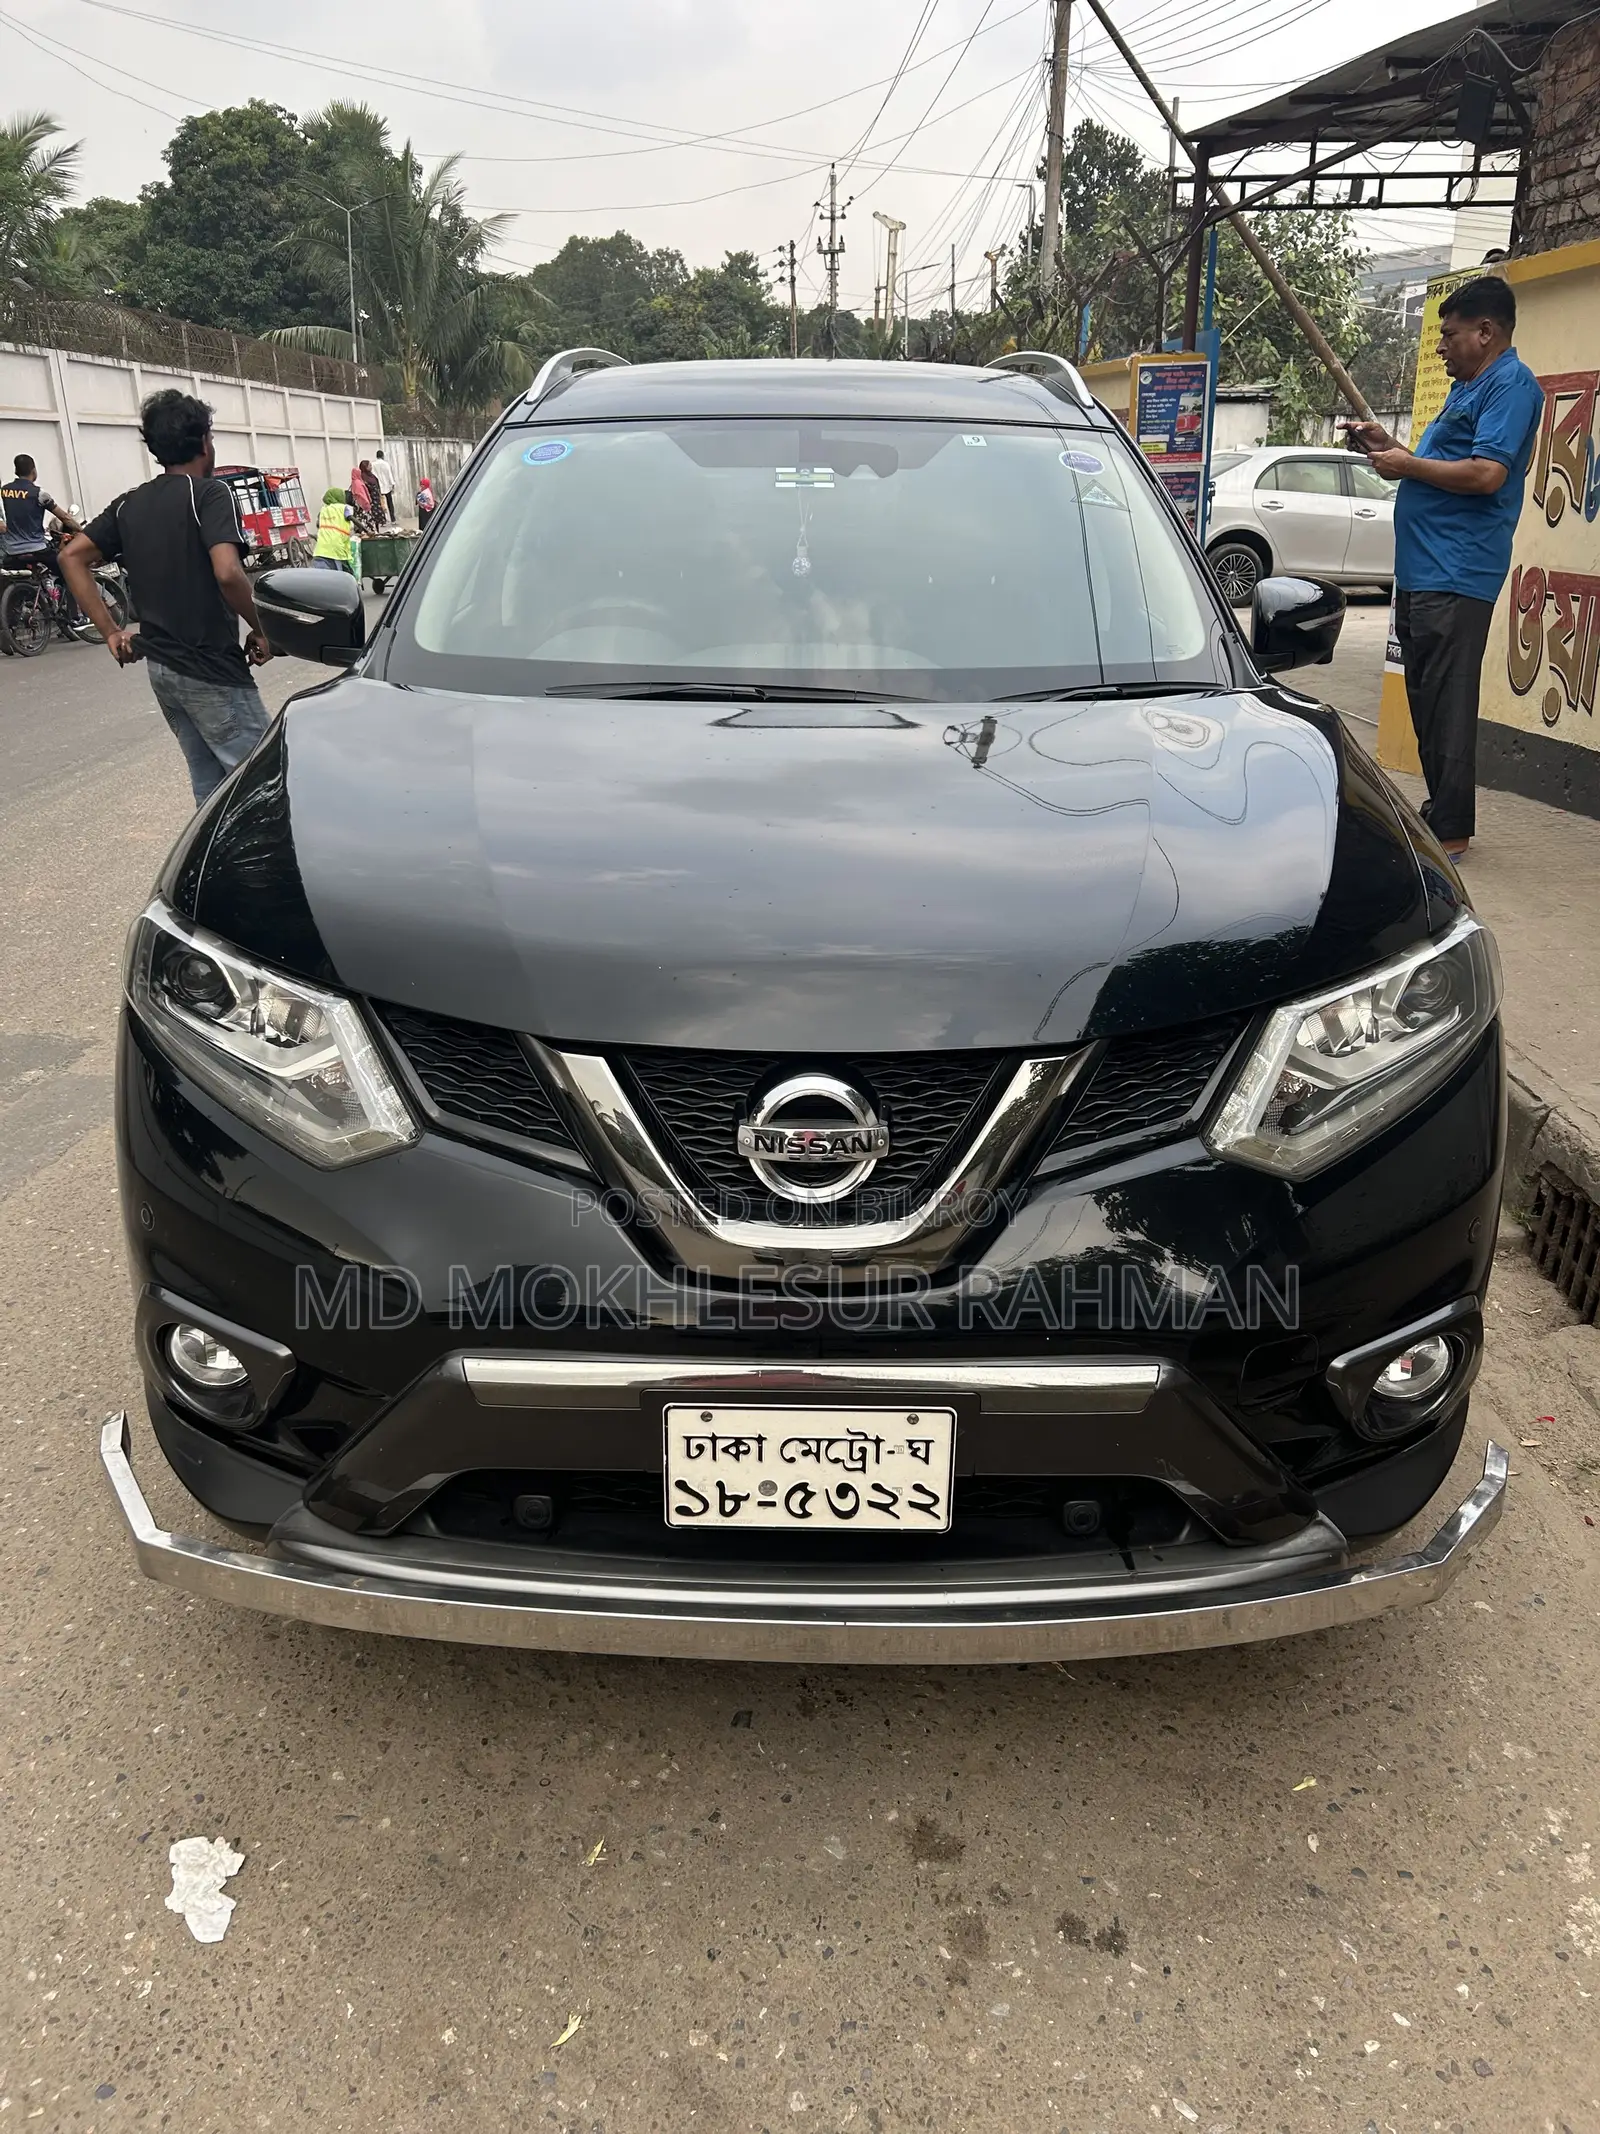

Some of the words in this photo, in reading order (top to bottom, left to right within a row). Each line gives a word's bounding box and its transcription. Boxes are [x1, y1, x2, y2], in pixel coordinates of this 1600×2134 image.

[2, 489, 28, 499] NAVY
[754, 1134, 872, 1155] NISSAN
[682, 1432, 768, 1463] ঢাকা
[780, 1428, 936, 1474] মেট্রো-ঘ
[674, 1479, 942, 1520] ১৮-৫৩২২
